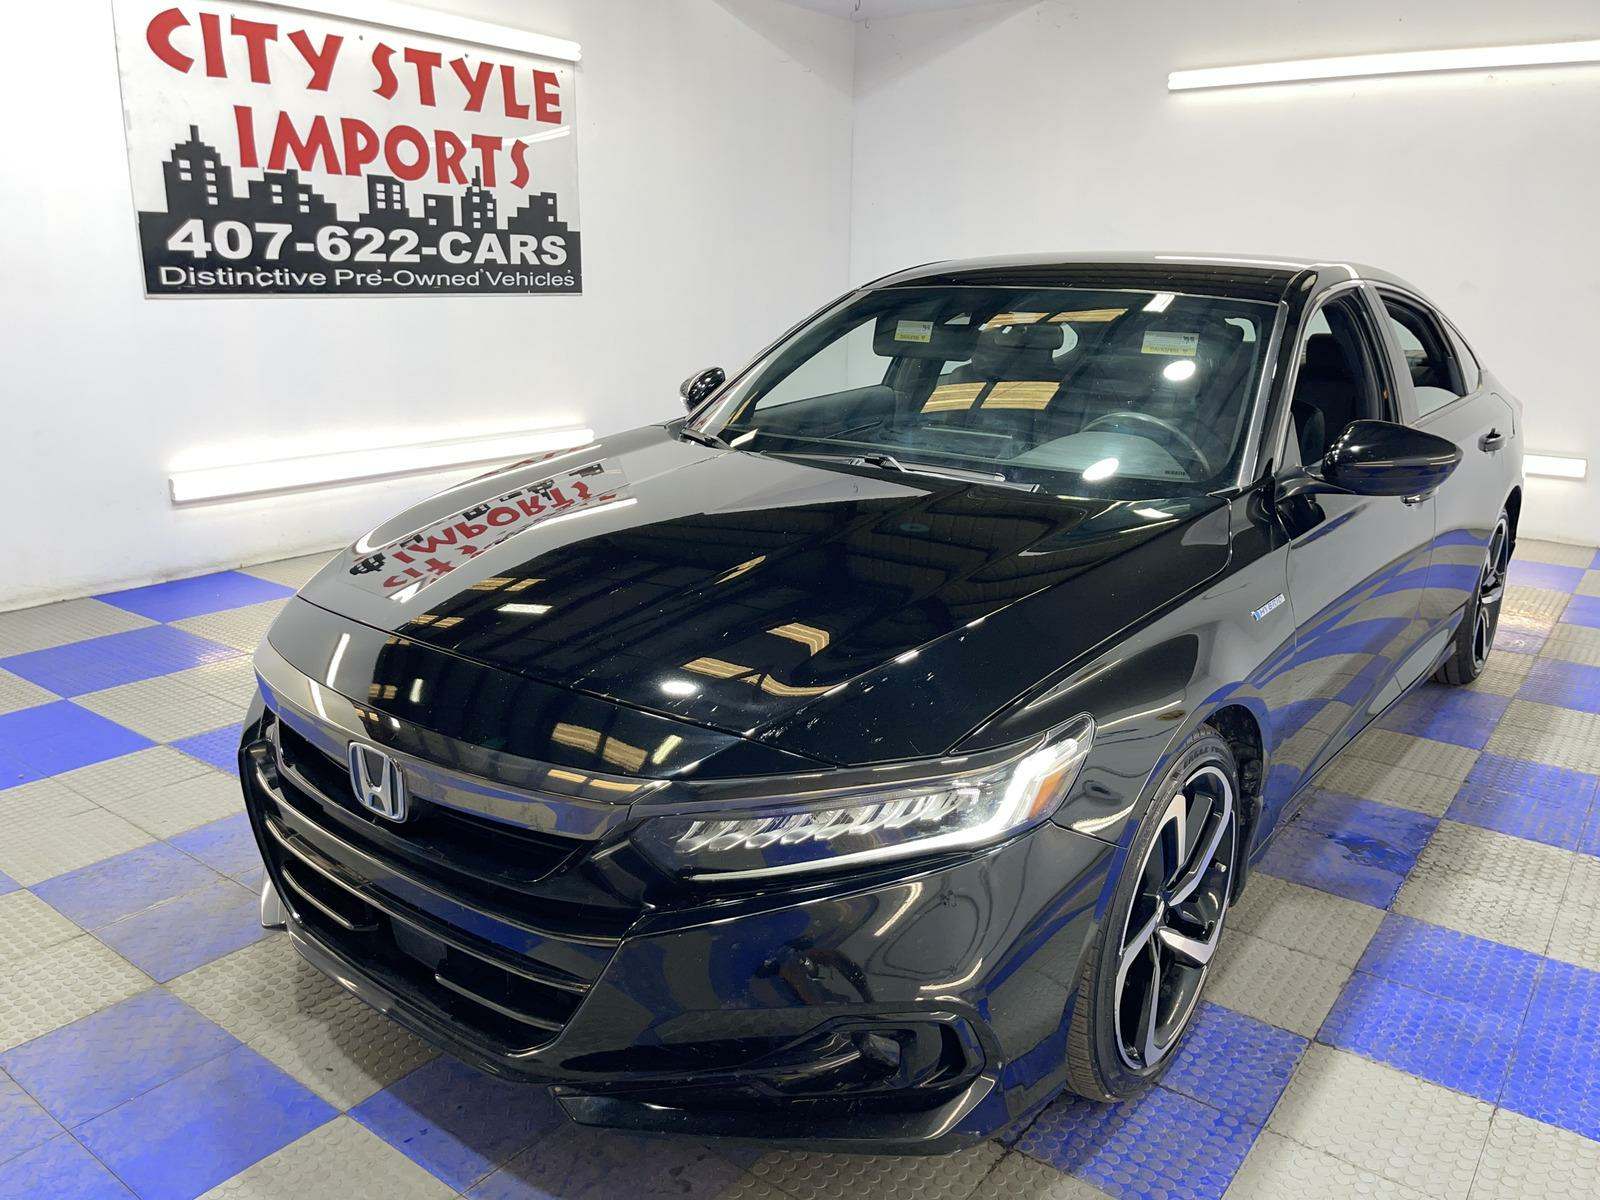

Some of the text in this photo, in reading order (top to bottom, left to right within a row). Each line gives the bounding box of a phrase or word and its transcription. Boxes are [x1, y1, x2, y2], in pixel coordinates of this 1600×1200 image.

[146, 8, 563, 125] CITY STYLE
[234, 105, 530, 190] IMPORTS
[167, 218, 568, 266] 407-622-CARS
[159, 266, 575, 288] Distinctive Pre-Owned Vehicles
